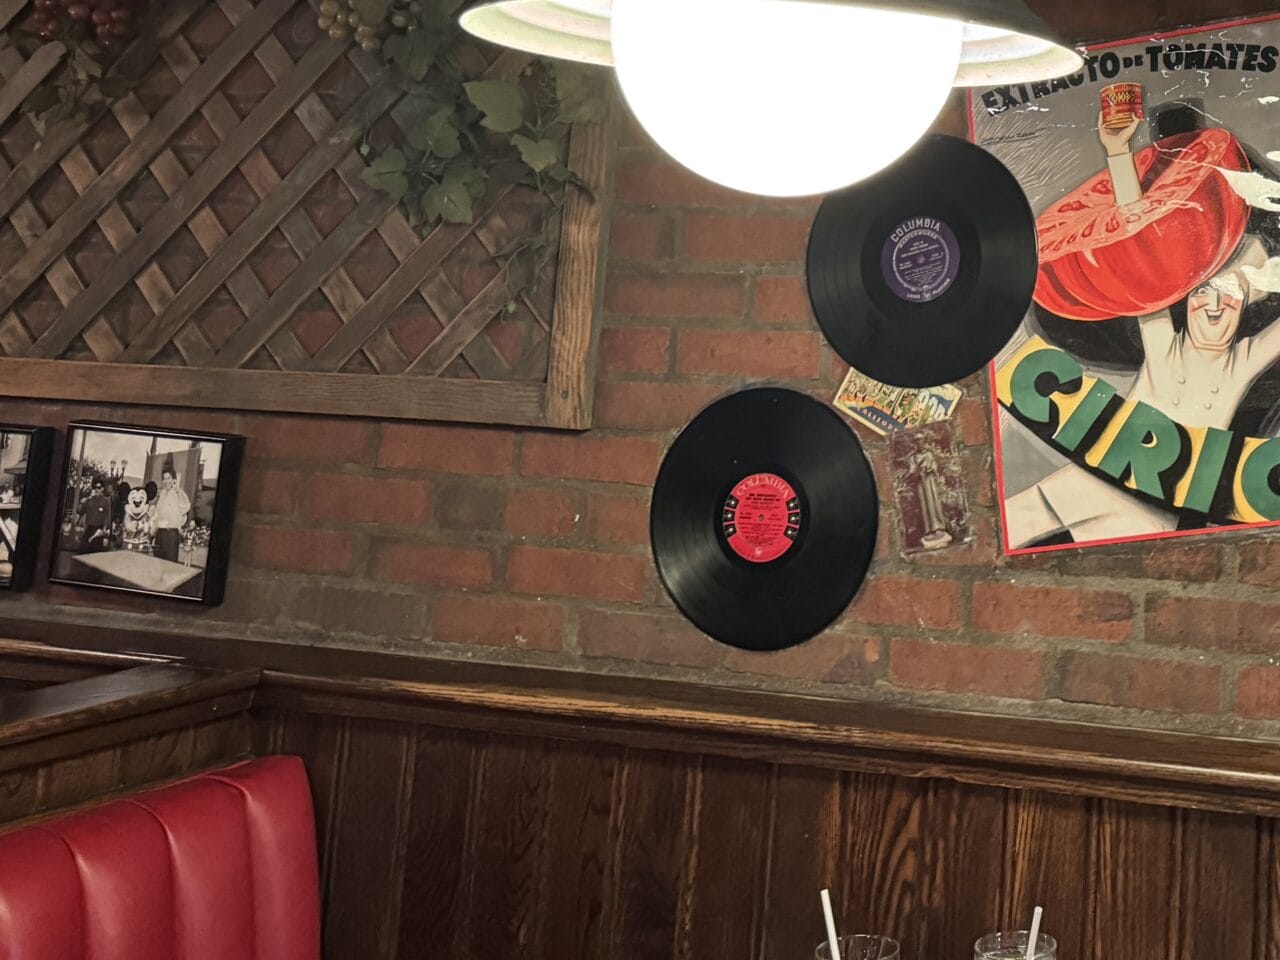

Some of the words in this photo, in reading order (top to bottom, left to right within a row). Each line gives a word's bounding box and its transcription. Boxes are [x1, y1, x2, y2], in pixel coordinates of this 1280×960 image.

[1123, 55, 1143, 69] DE
[1146, 43, 1280, 73] TOMATES
[890, 218, 941, 243] COLUMBIA
[736, 475, 790, 498] COLUMBIA
